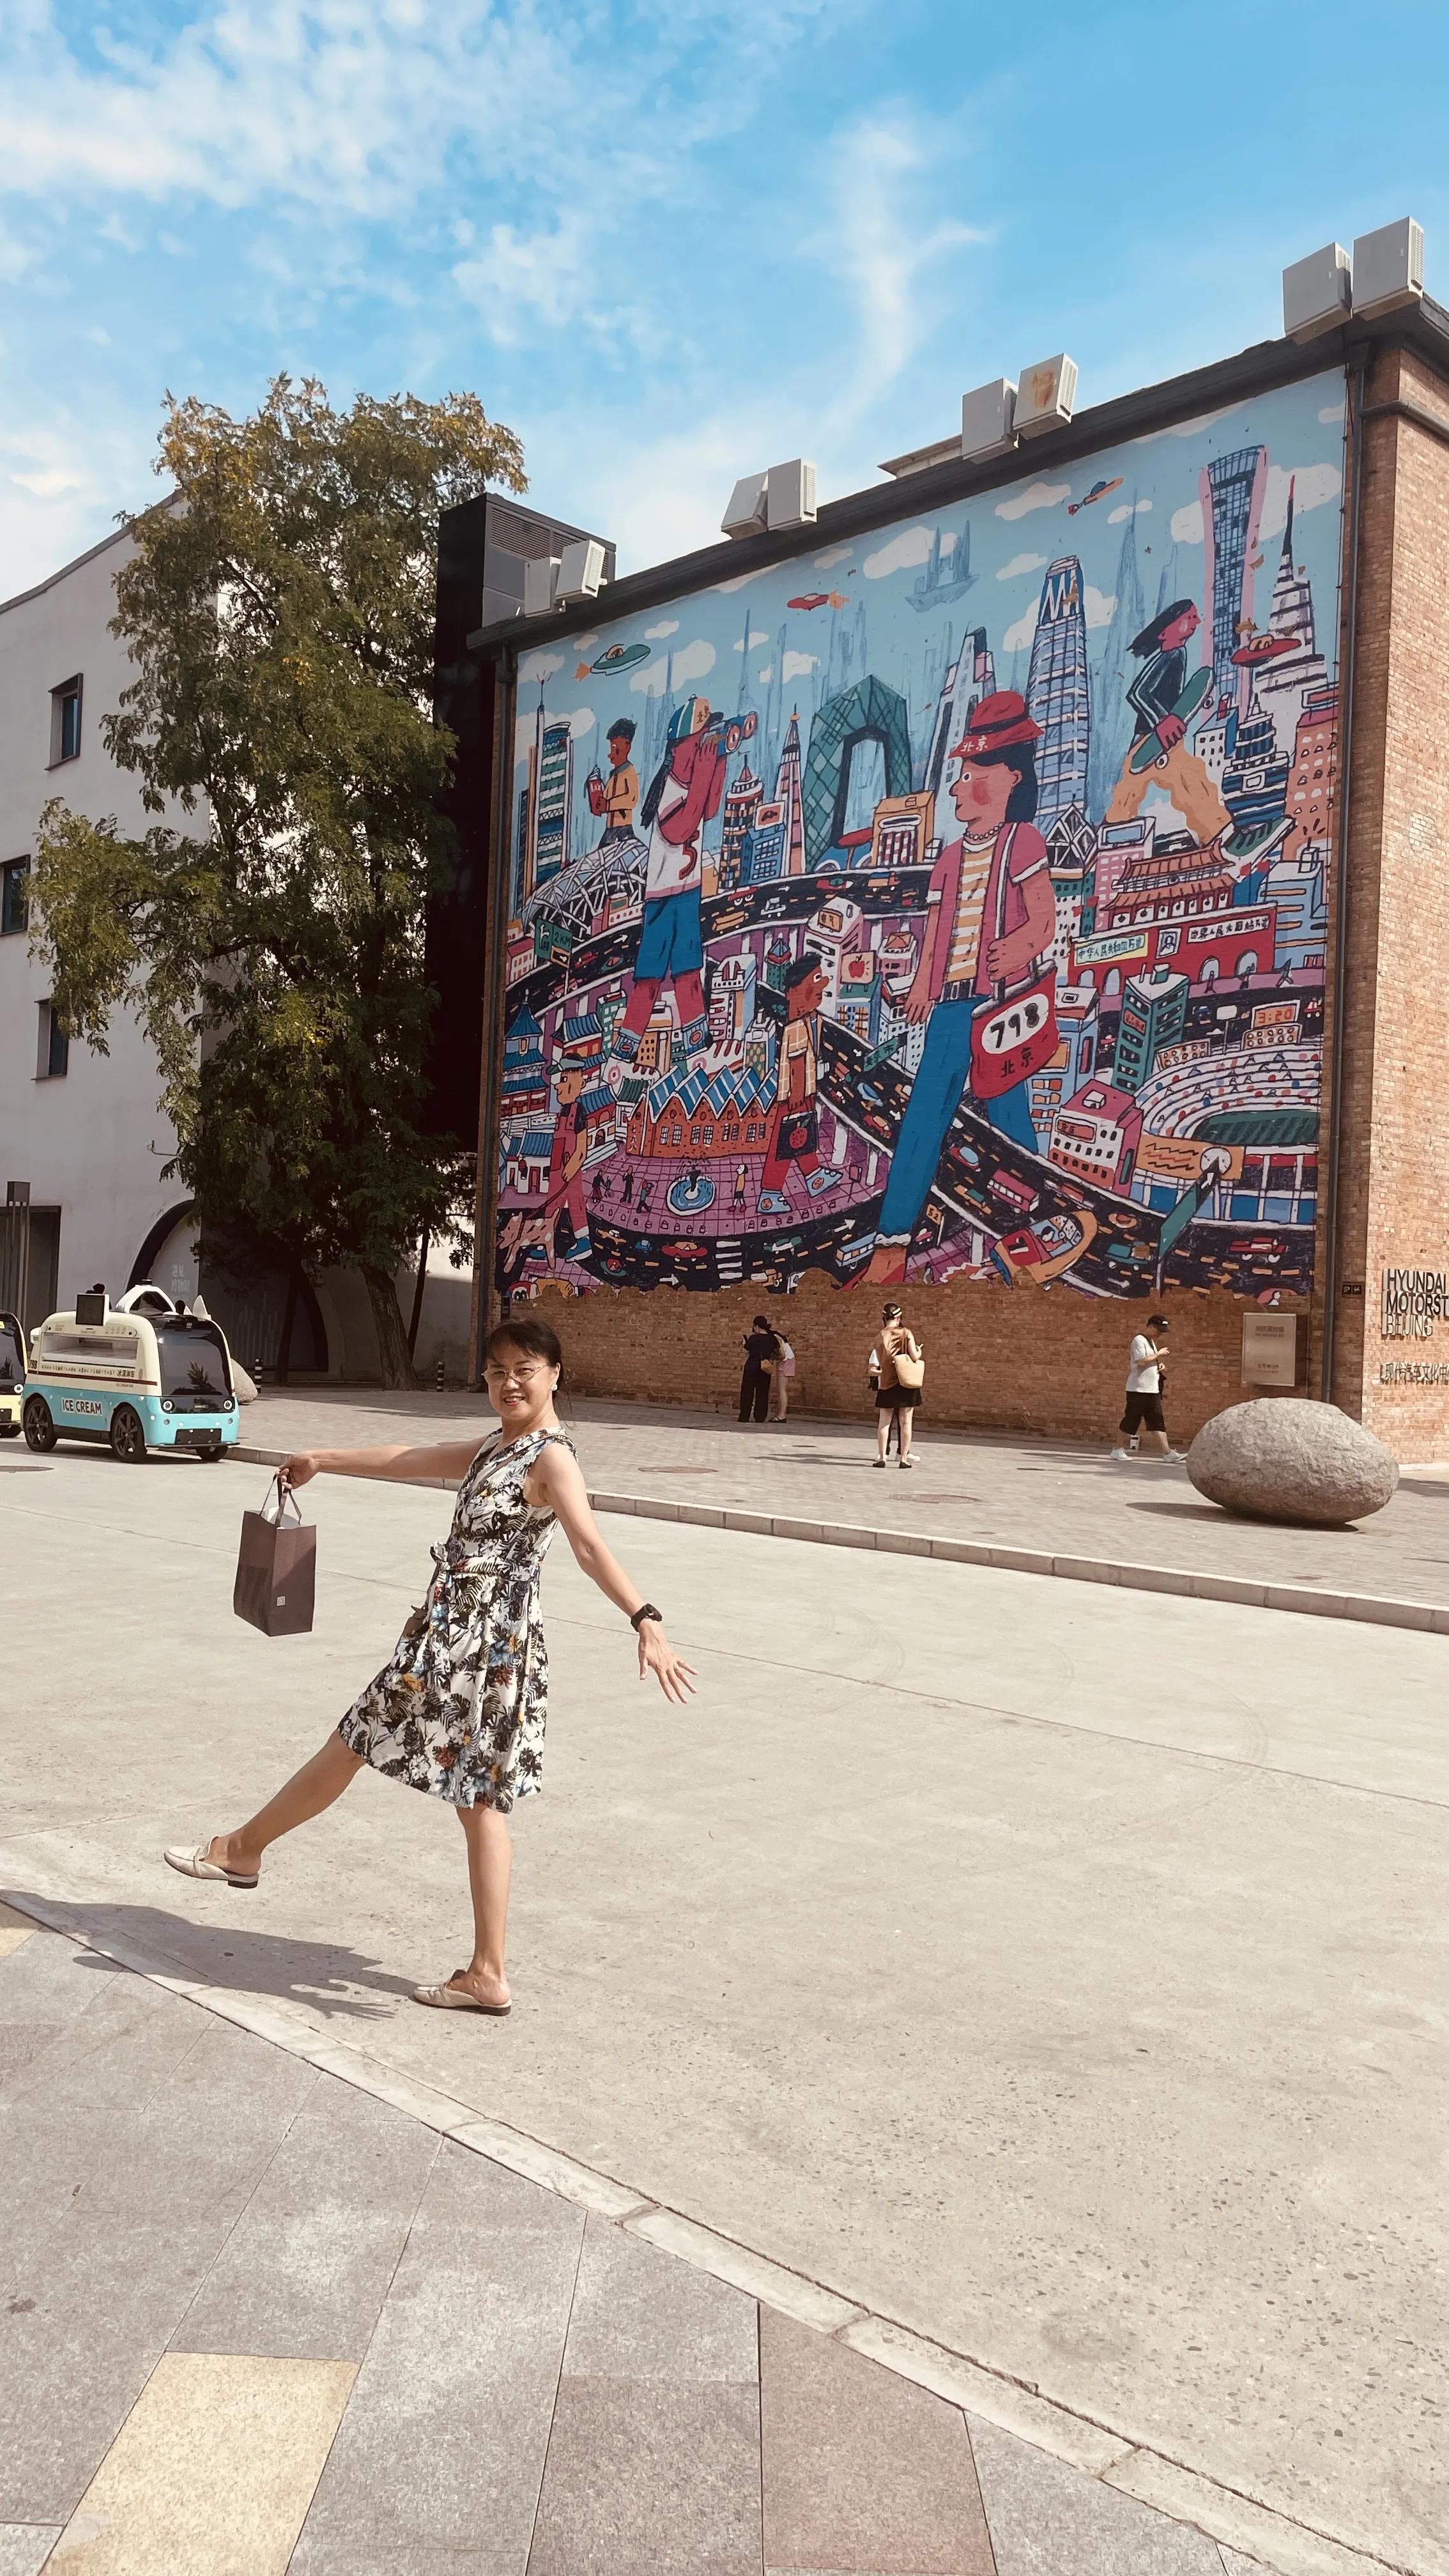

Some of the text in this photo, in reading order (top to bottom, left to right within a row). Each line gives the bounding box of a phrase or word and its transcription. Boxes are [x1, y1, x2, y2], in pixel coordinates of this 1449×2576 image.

[960, 734, 988, 752] 北京
[553, 931, 571, 947] 2KM
[1078, 936, 1142, 959] 中华人民共和国万岁
[990, 1002, 1040, 1048] 798
[1257, 1008, 1293, 1024] 3:20
[1000, 1046, 1034, 1078] 北京
[1386, 1268, 1446, 1294] HYUNDAI
[1386, 1290, 1449, 1316] MOTORST
[1386, 1313, 1434, 1337] BEIJING
[28, 1359, 38, 1370] 798
[1384, 1363, 1449, 1381] 现代汽车文化中
[62, 1398, 102, 1414] ICE CREAM
